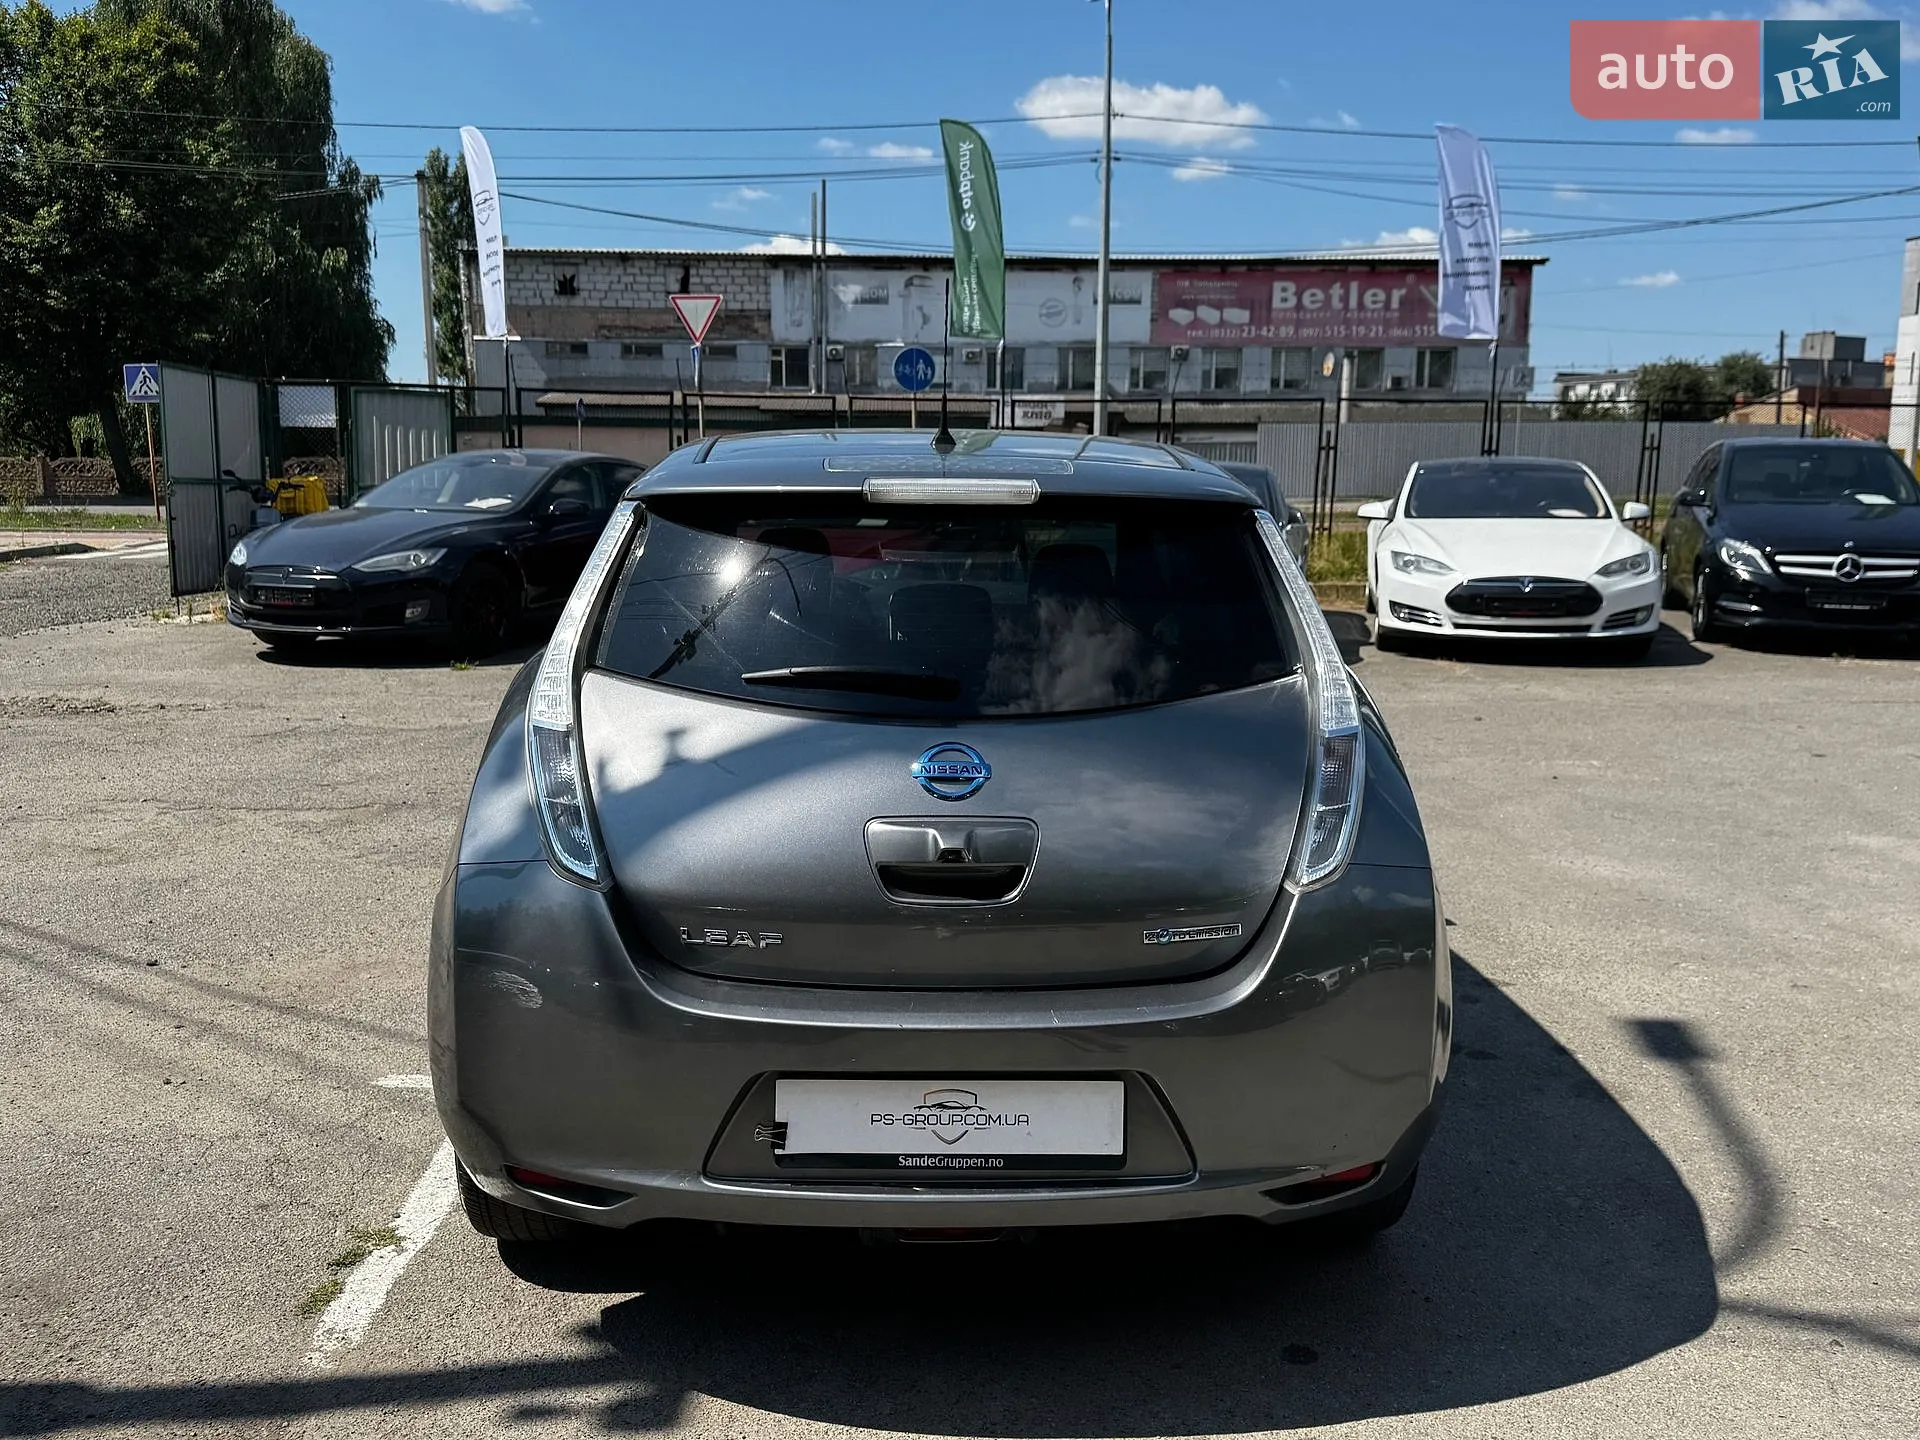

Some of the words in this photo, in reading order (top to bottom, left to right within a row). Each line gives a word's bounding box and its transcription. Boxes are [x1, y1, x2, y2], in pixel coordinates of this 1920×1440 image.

[1272, 281, 1407, 309] Betler
[920, 765, 983, 775] NISSAN
[680, 926, 783, 949] LEAF
[870, 1113, 1030, 1127] PS-GROUP.COM.UA
[898, 1155, 1004, 1169] SandeGruppen.no
